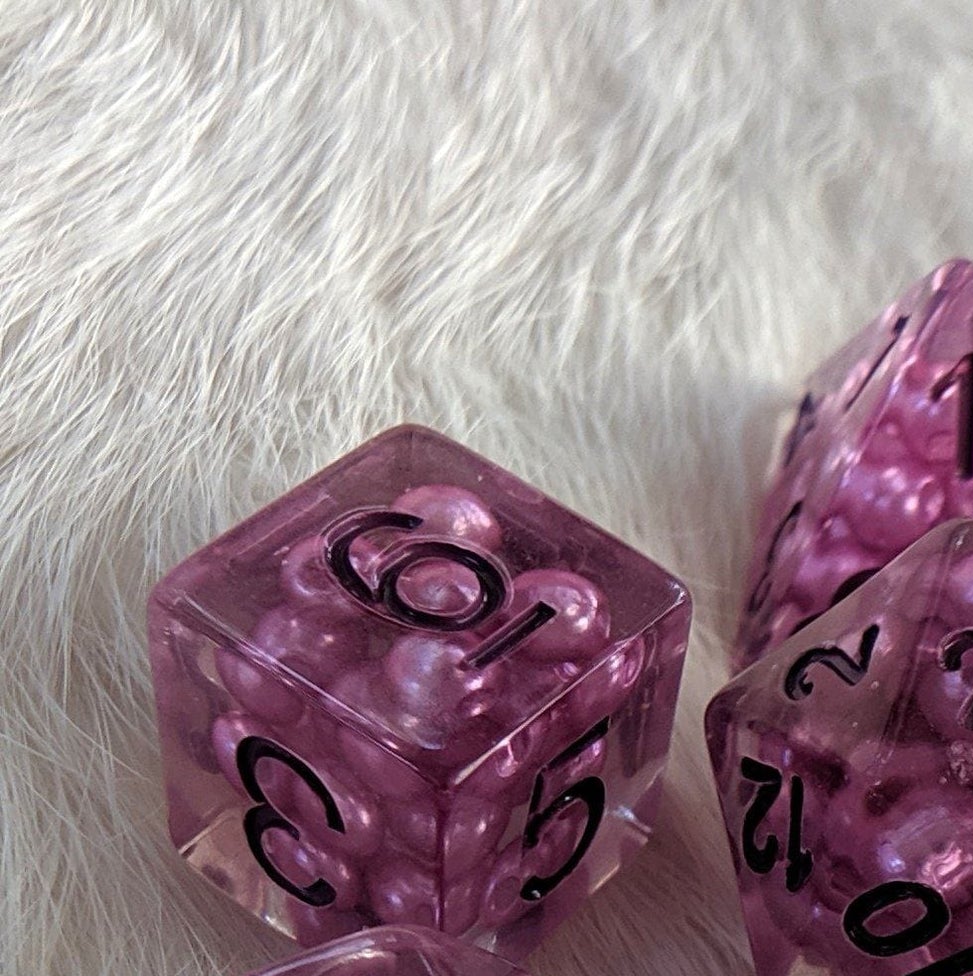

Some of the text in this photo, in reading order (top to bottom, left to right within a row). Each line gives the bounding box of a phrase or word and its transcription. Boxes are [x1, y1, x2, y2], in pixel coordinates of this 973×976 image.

[323, 507, 512, 633] 6
[783, 623, 881, 701] 2
[236, 735, 345, 906] 3
[520, 715, 611, 901] 5
[740, 755, 814, 893] 12
